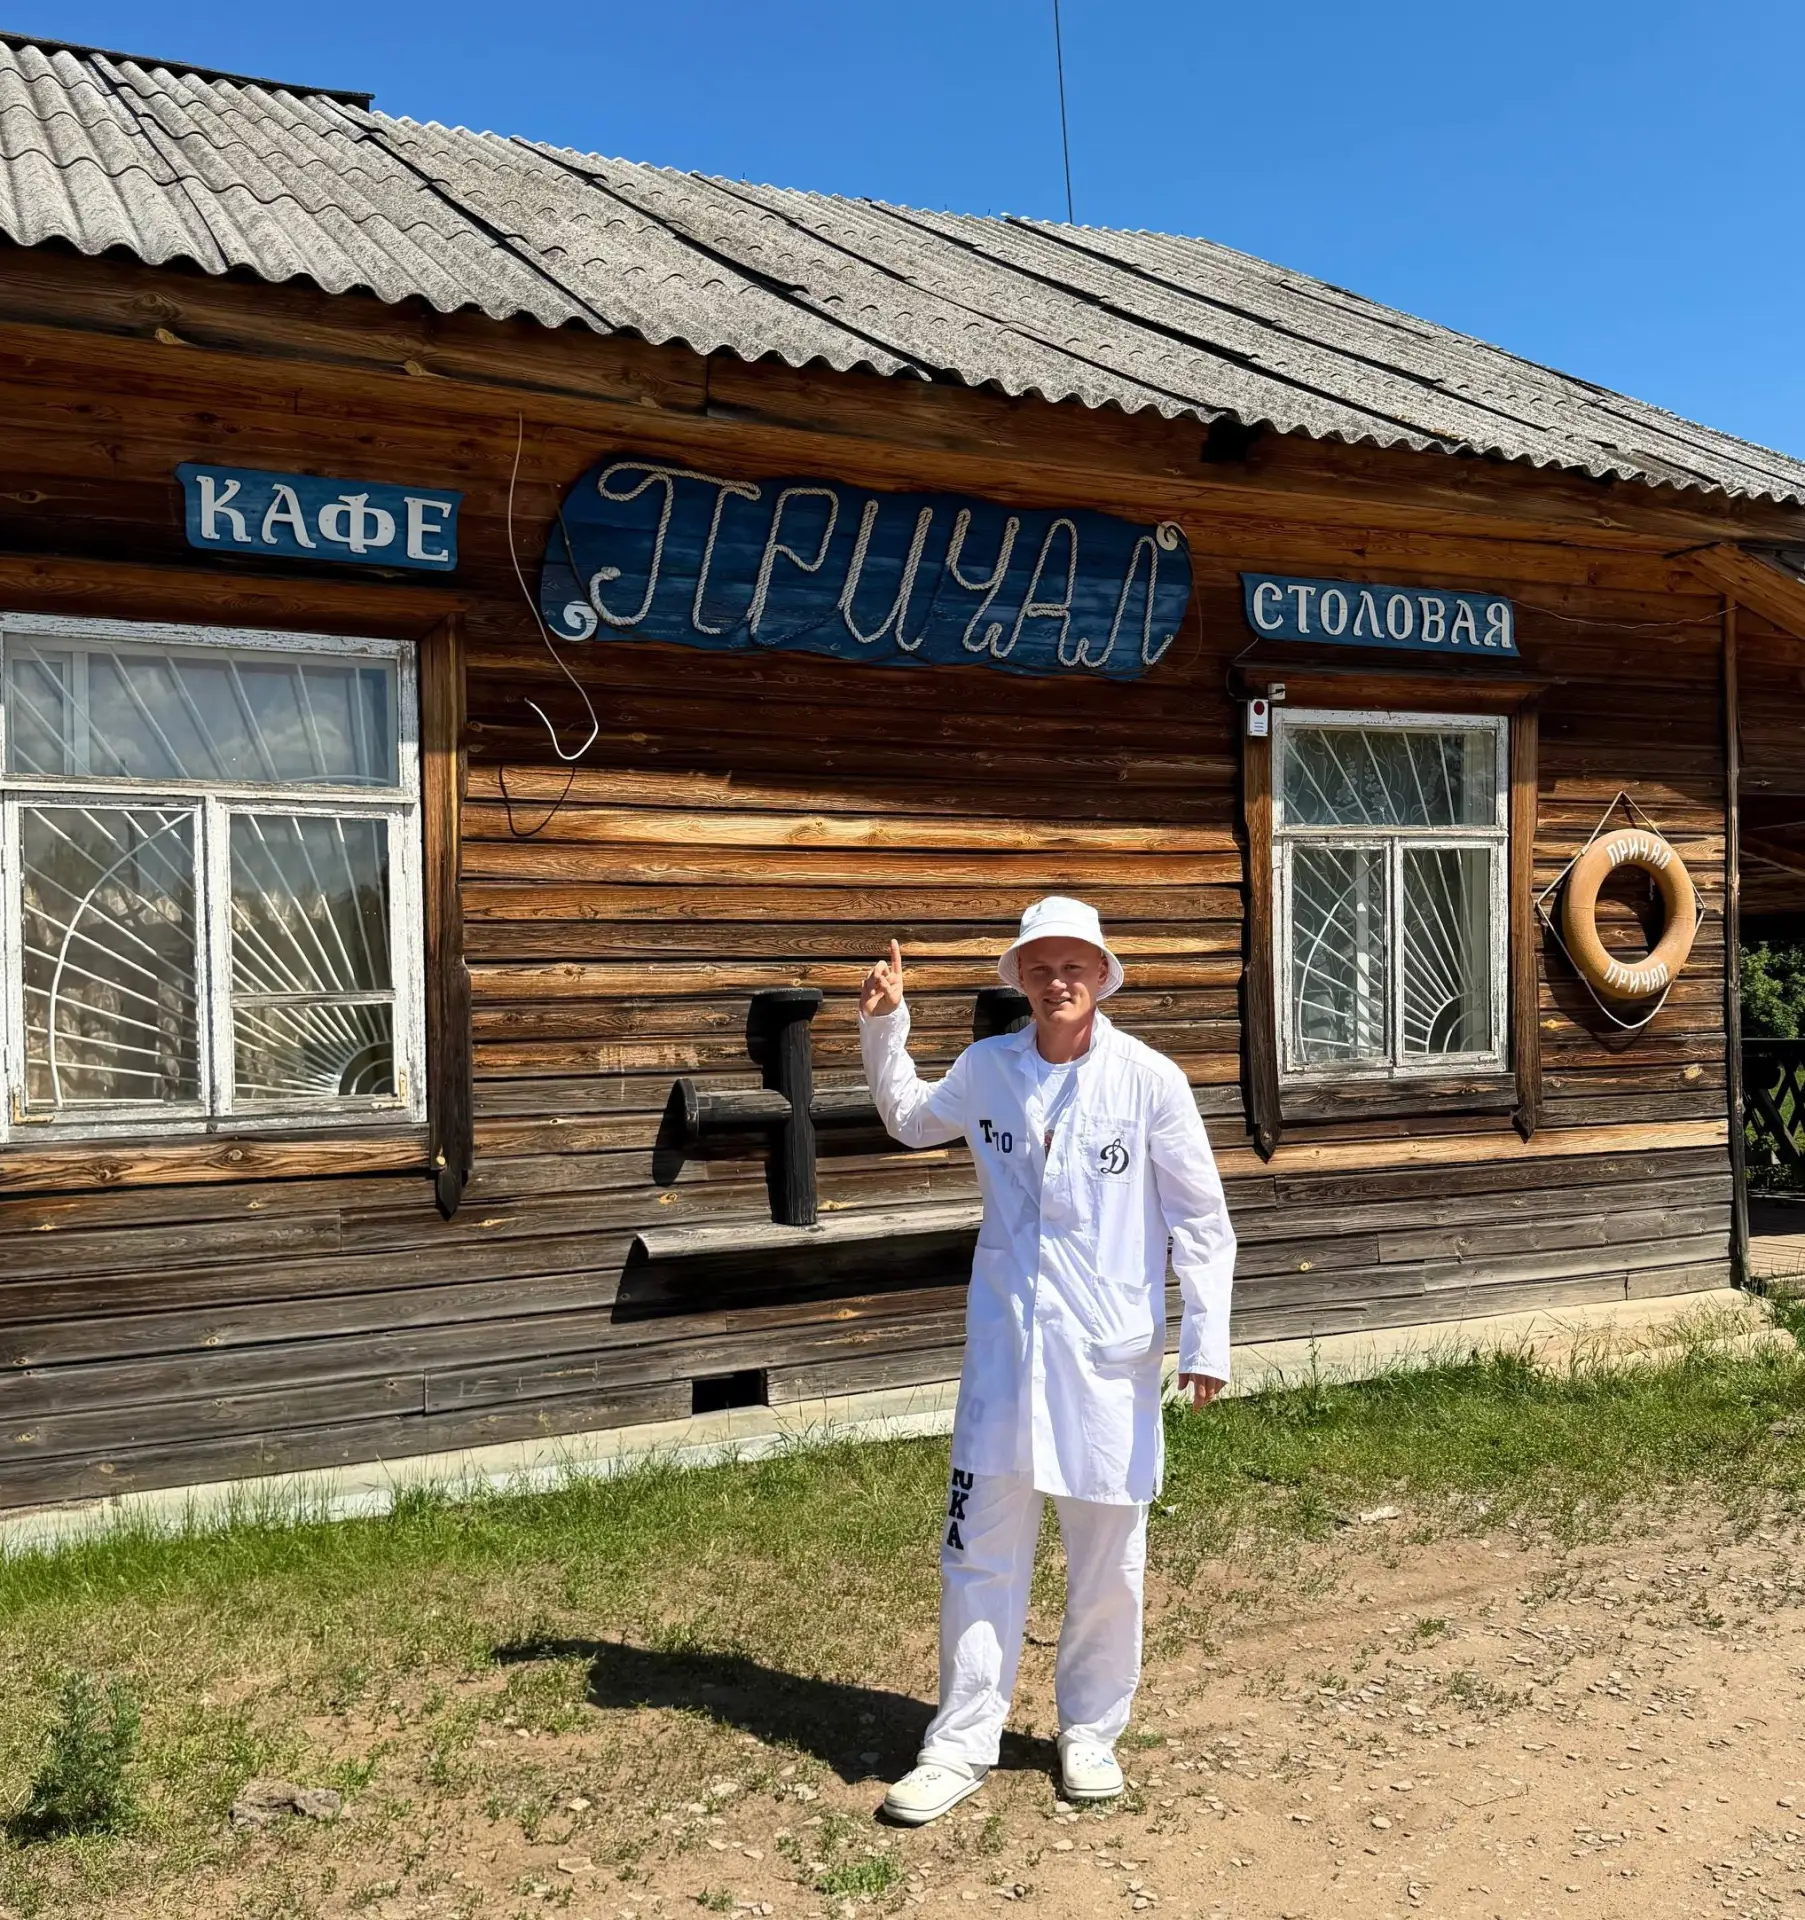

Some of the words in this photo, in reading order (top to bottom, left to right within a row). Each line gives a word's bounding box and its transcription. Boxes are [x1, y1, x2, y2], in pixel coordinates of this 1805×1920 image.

[196, 475, 452, 562] КАФЕ
[590, 461, 1174, 668] ПРИЧАЛ
[1253, 582, 1512, 648] СТОЛОВАЯ
